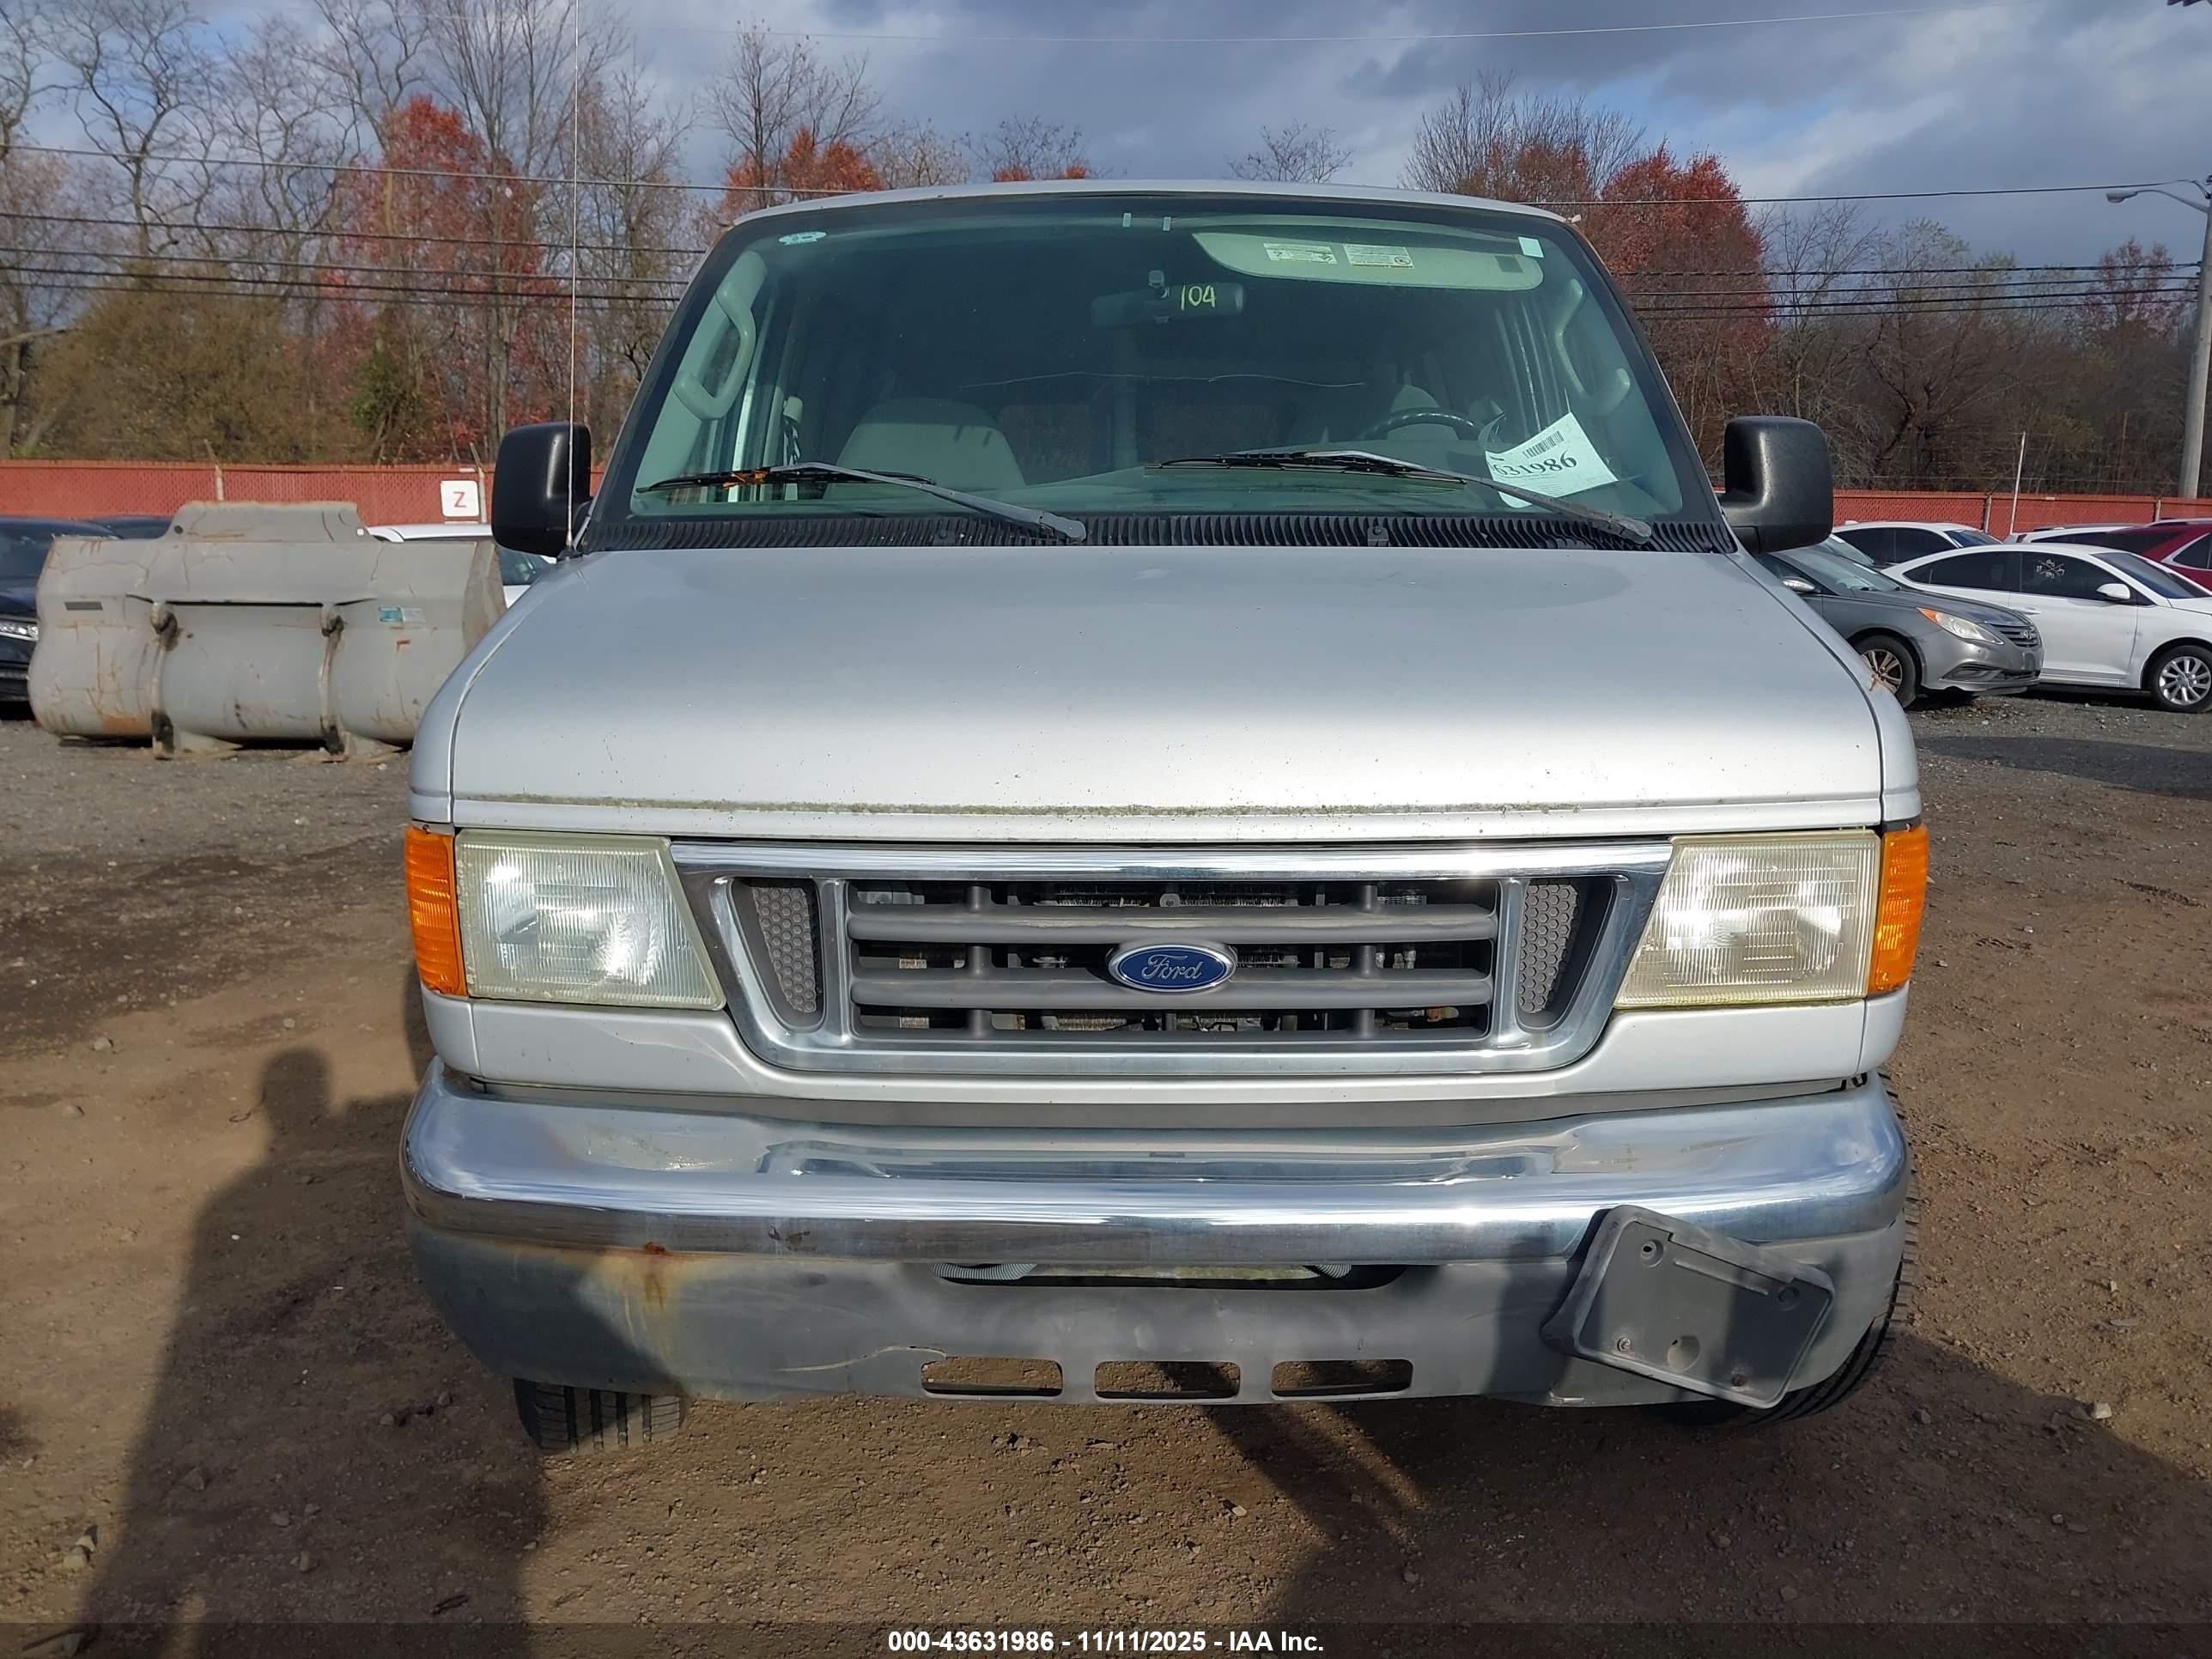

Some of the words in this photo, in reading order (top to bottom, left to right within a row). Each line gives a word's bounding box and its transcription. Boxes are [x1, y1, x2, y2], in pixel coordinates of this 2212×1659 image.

[1181, 284, 1216, 311] 104
[453, 491, 467, 508] Z
[1141, 953, 1205, 980] Ford
